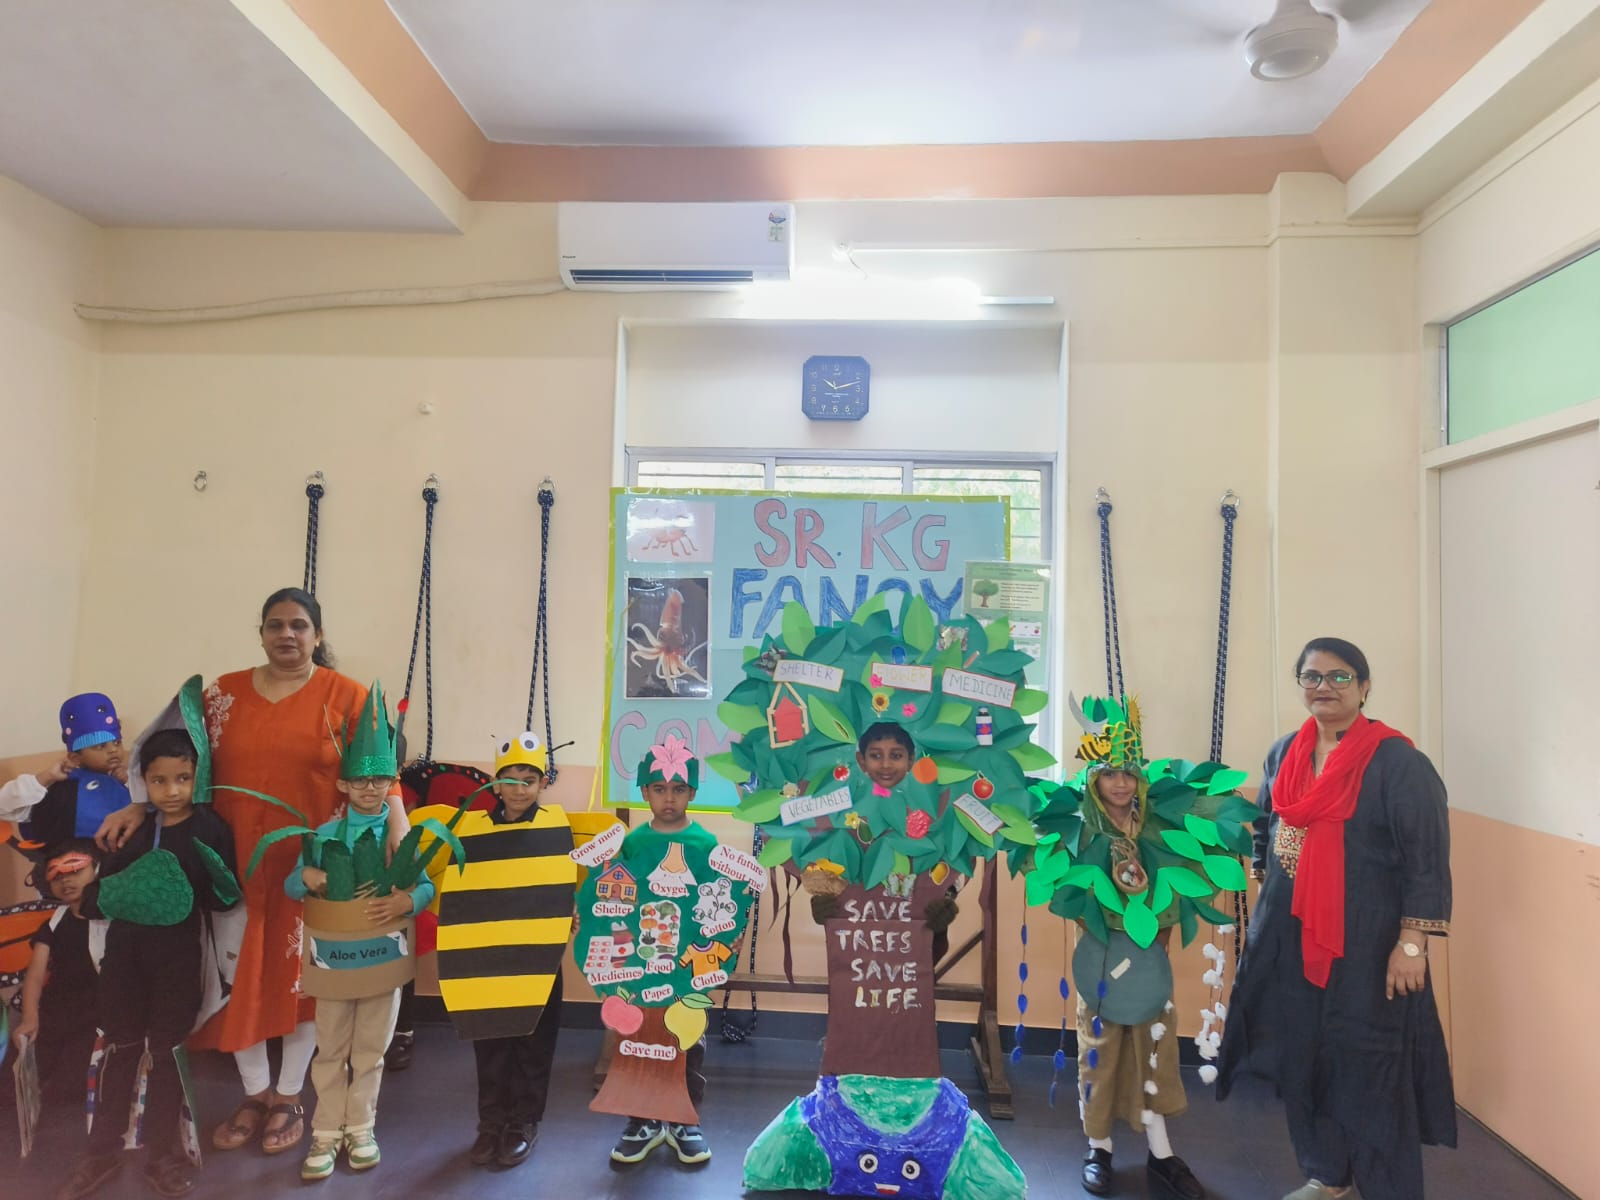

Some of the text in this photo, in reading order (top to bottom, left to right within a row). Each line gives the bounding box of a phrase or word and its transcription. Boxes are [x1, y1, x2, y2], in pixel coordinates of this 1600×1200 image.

[860, 502, 951, 572] KG
[780, 662, 834, 681] SHELTER
[949, 673, 1013, 700] MEDICINE
[788, 791, 850, 818] VEGETABLES
[570, 825, 621, 861] Grow more
[592, 847, 615, 865] trees
[720, 846, 763, 876] No future
[710, 859, 746, 881] without
[595, 904, 632, 914] Shelter
[844, 899, 912, 923] SAVE
[701, 919, 736, 938] Cotton
[329, 946, 388, 961] Aloe Vera
[590, 969, 643, 983] Medicines
[646, 960, 673, 973] Food
[851, 958, 917, 982] SAVE
[692, 972, 726, 988] Cloths
[644, 987, 671, 1000] Paper
[624, 1042, 676, 1059] Save me!
